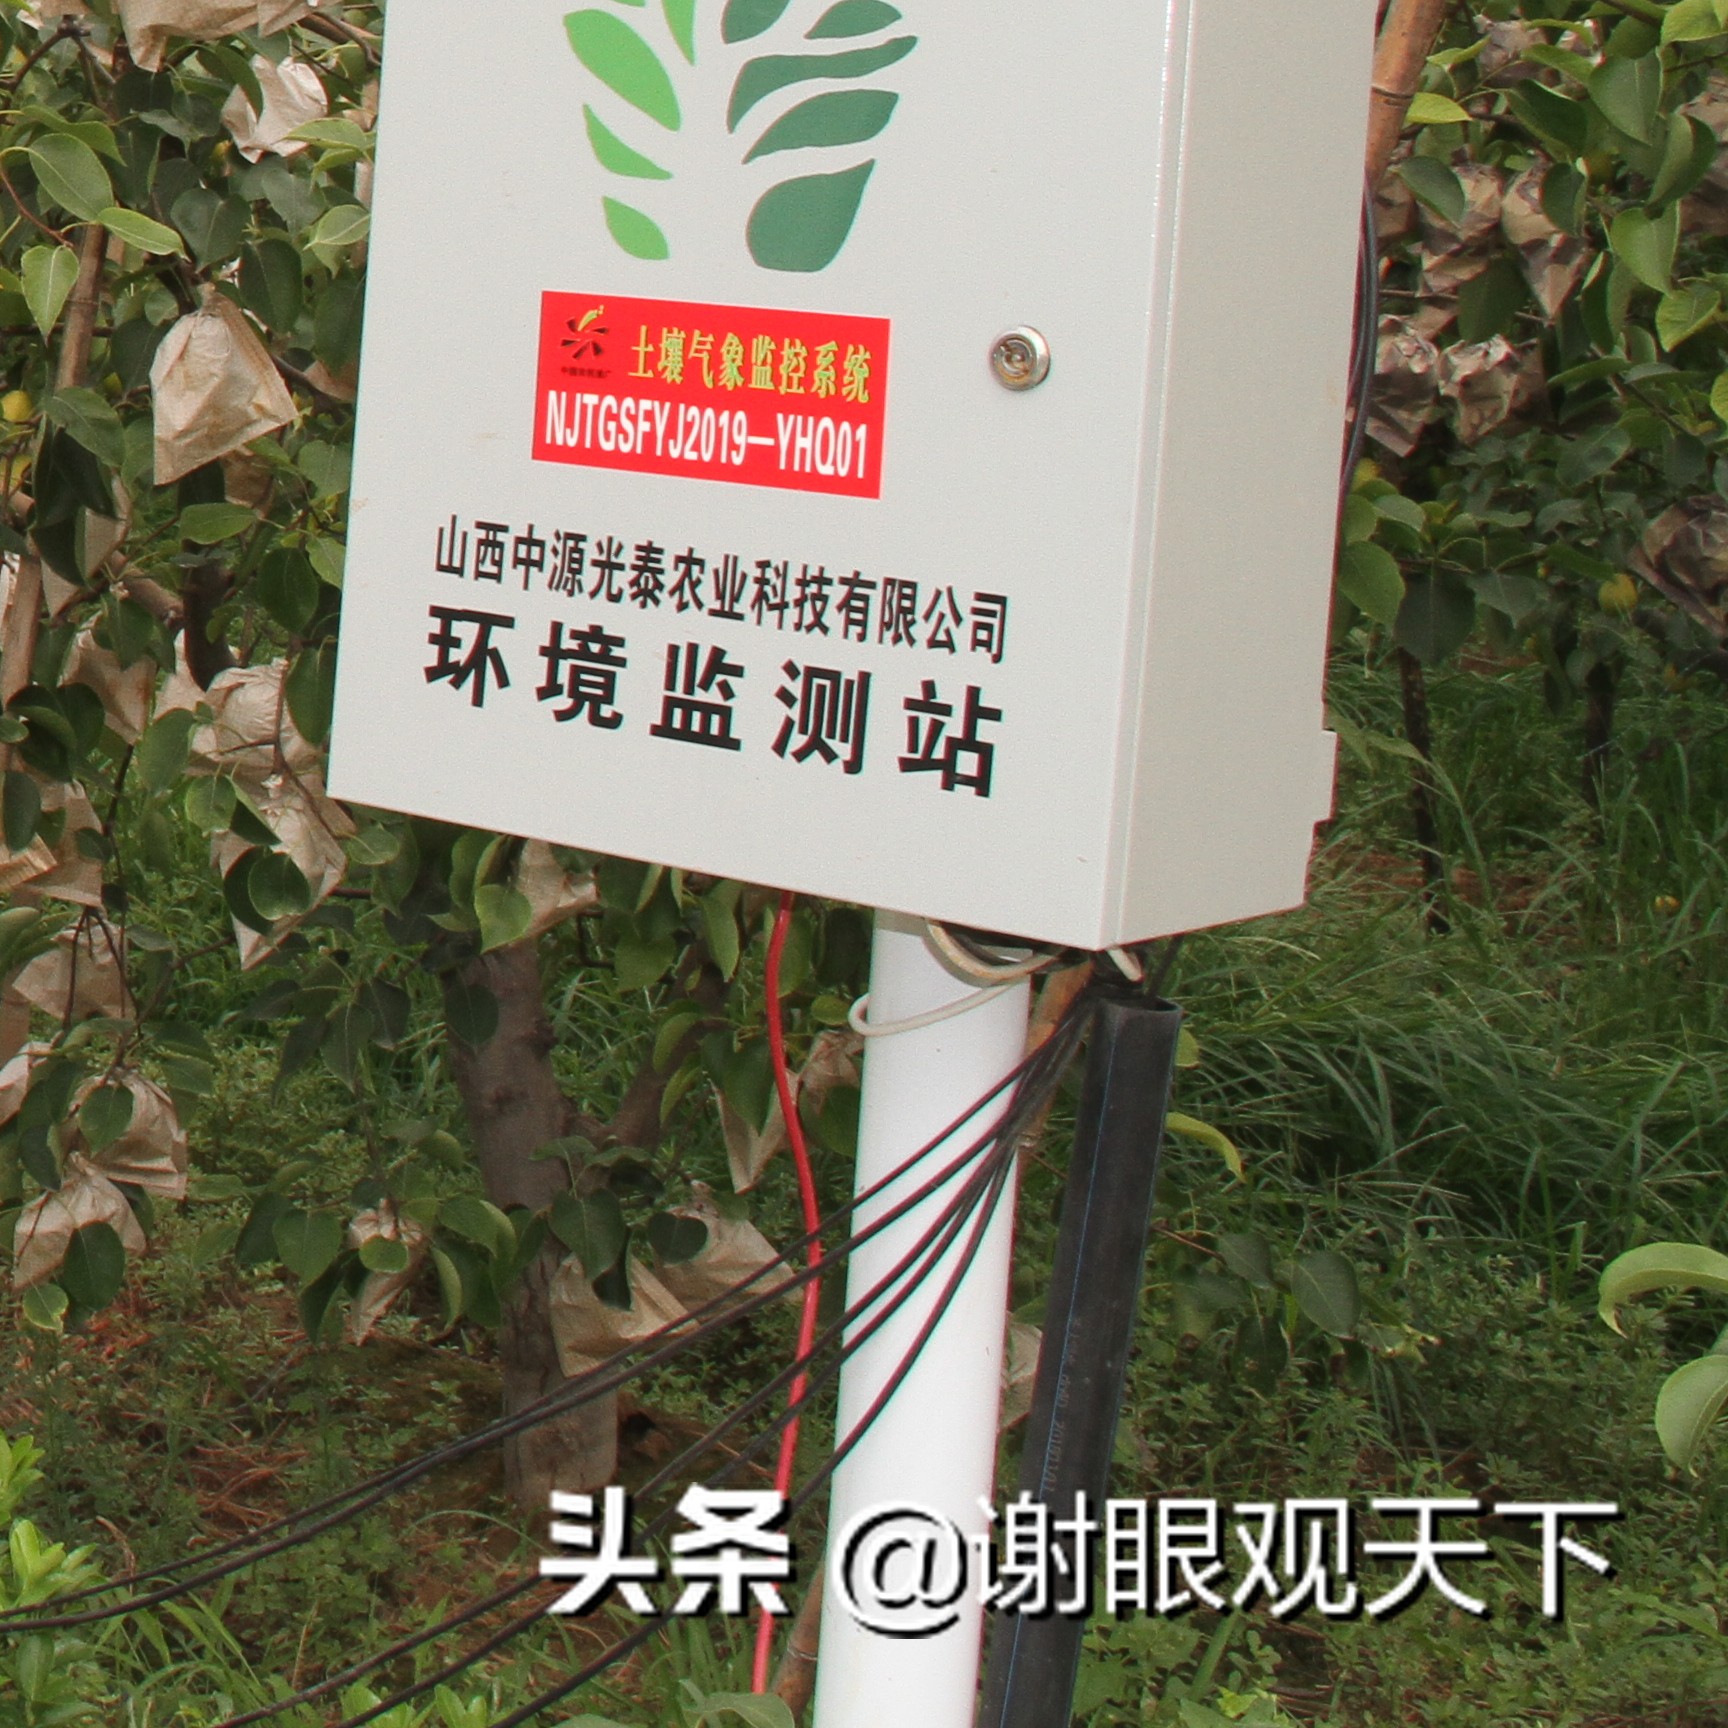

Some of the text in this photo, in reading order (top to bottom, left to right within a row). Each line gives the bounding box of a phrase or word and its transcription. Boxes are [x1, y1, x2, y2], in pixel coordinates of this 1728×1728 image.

[628, 324, 873, 404] 土壤气象监控系统
[434, 514, 1009, 664] 山西中源光泰农业科技有限公司
[423, 604, 1004, 799] 环境监测站
